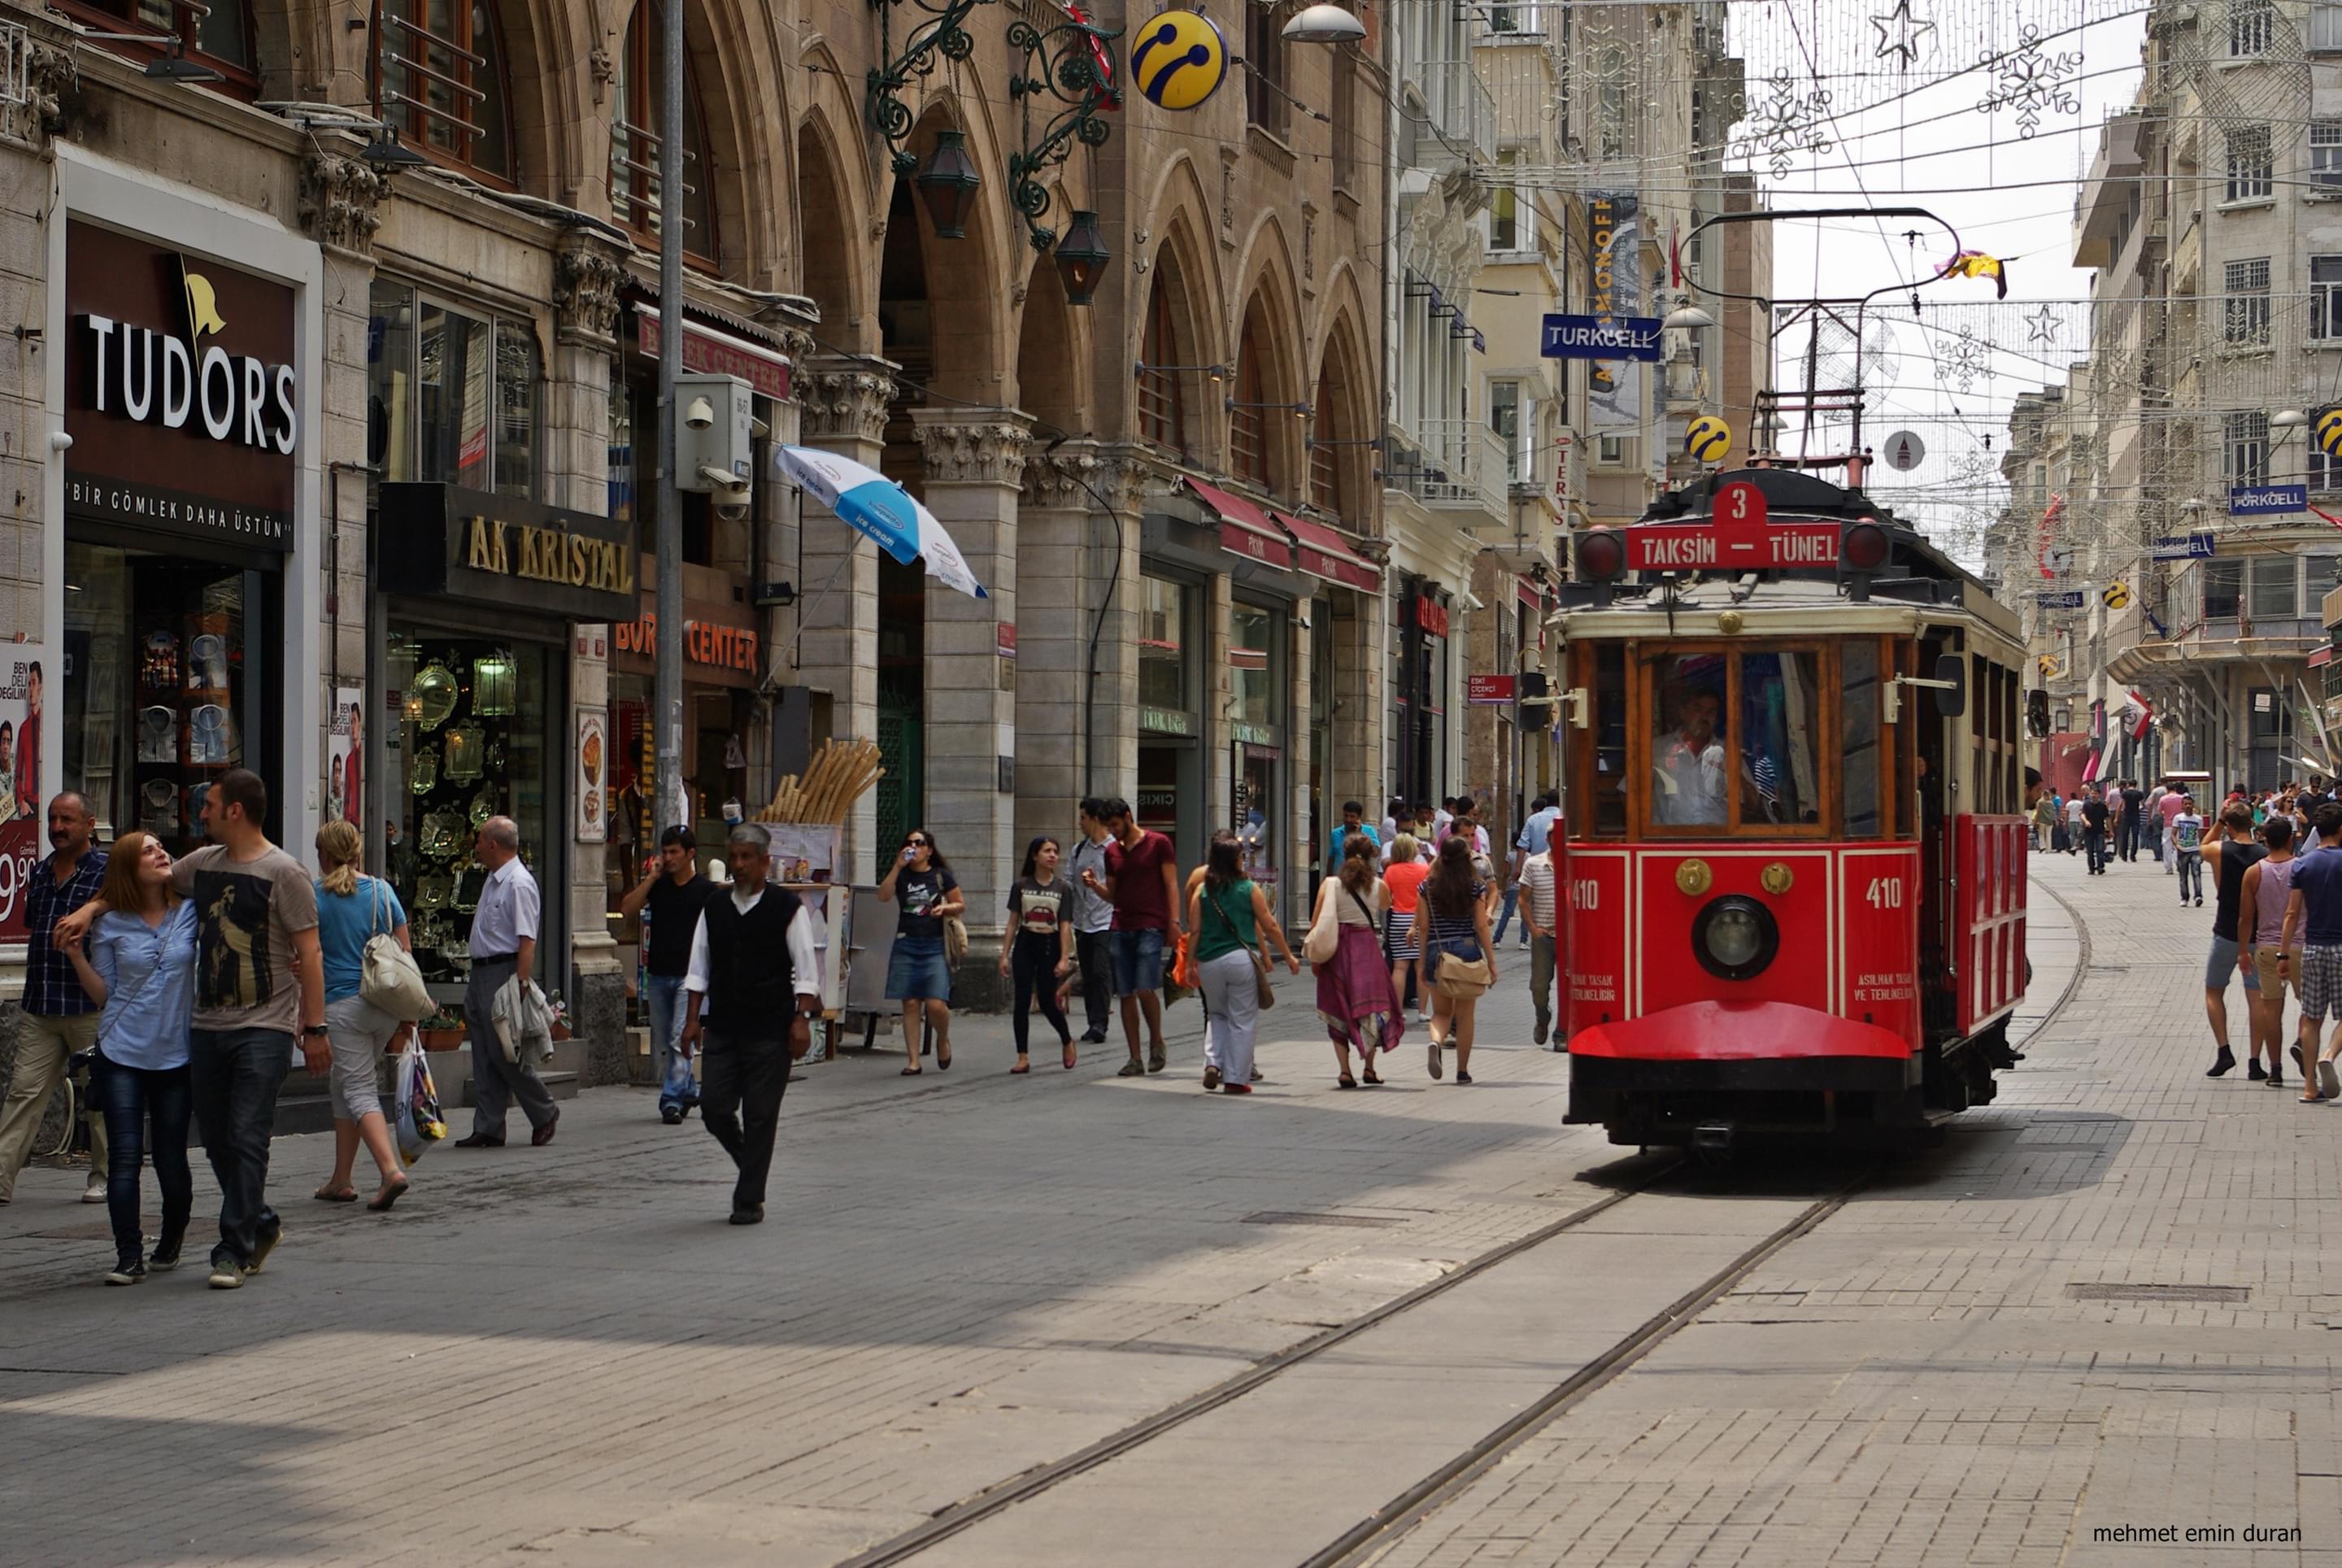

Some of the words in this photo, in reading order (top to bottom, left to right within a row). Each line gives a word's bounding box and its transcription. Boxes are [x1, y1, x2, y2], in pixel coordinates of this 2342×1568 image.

[1549, 326, 1654, 348] TURKCELL
[89, 313, 296, 455] TUDORS
[111, 490, 177, 520] GÖMLEK
[186, 504, 226, 528] DAHA
[1731, 489, 1746, 518] 3
[855, 514, 868, 527] ice
[868, 525, 895, 547] cream
[468, 516, 509, 574] AK
[517, 519, 634, 595] KRİSTAL
[1641, 533, 1716, 564] TAKSİM
[1769, 531, 1839, 562] TÜNEL
[685, 620, 758, 677] CENTER
[14, 661, 28, 674] BEN
[340, 703, 350, 714] BEN
[1572, 879, 1599, 910] 410
[1866, 878, 1901, 908] 410
[1588, 975, 1613, 986] YASAK
[1854, 989, 1866, 1001] VE
